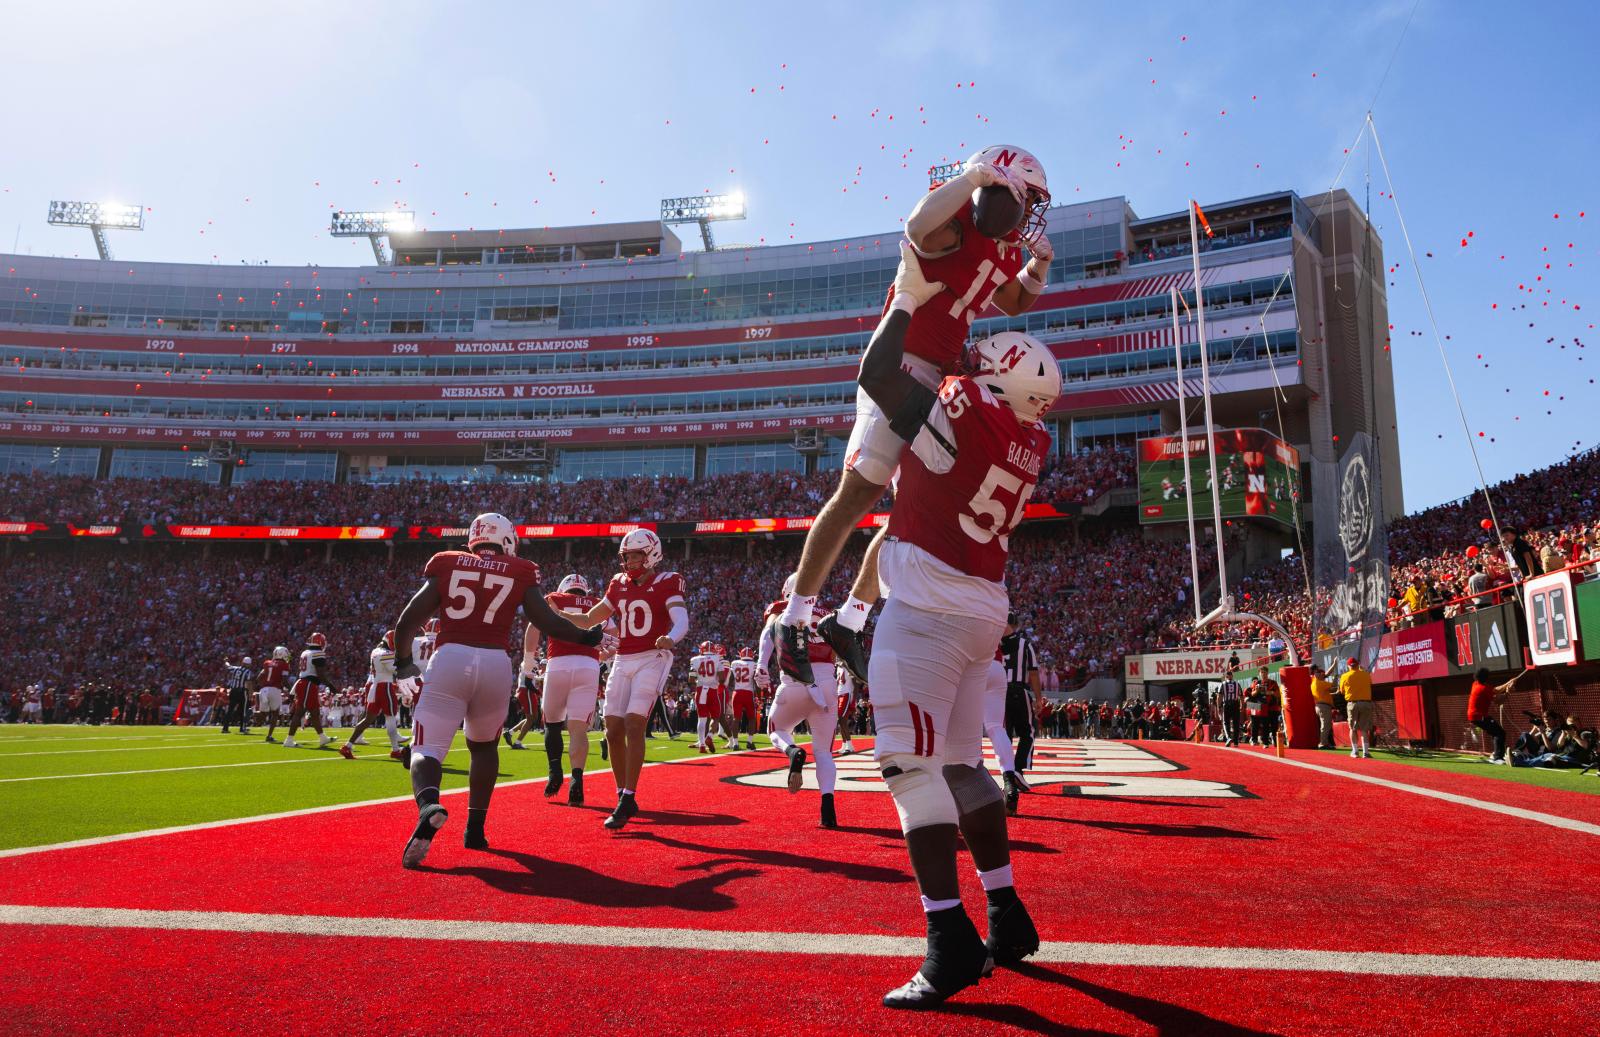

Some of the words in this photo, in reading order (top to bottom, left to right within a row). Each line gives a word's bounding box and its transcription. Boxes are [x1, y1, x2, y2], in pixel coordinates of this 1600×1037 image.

[992, 149, 1017, 168] N
[145, 339, 175, 350] 1970
[271, 343, 297, 353] 1971
[392, 343, 419, 353] 1994
[454, 341, 516, 353] NATIONAL
[517, 339, 590, 351] CHAMPIONS
[626, 335, 654, 346] 1995
[744, 327, 772, 339] 1997
[1000, 345, 1027, 370] N
[441, 386, 506, 399] NEBRASKA
[513, 385, 525, 397] N
[531, 383, 596, 396] FOOTBALL
[938, 378, 972, 420] 55
[51, 425, 70, 433] 1935
[80, 426, 99, 434] 1936
[108, 427, 126, 435] 1937
[137, 428, 156, 436] 1940
[164, 429, 183, 437] 1963
[192, 429, 211, 437] 1964
[219, 430, 237, 438] 1966
[246, 430, 265, 438] 1969
[352, 431, 370, 439] 1975
[456, 430, 517, 439] CONFERENCE
[519, 429, 573, 438] CHAMPIONS
[608, 427, 625, 435] 1982
[633, 426, 651, 434] 1983
[660, 425, 677, 433] 1984
[711, 422, 728, 430] 1991
[736, 421, 754, 429] 1992
[763, 420, 781, 428] 1993
[789, 418, 807, 426] 1994
[816, 416, 834, 425] 1995
[842, 414, 857, 423] 199
[1248, 474, 1265, 493] N
[269, 528, 299, 536] TOUCHDOWN
[525, 526, 555, 536] TOUCHDOWN
[695, 521, 725, 531] TOUCHDOWN
[456, 555, 510, 573] PRITCHETT
[445, 569, 515, 625] 57
[617, 599, 653, 639] 10
[1454, 622, 1474, 666] N
[1396, 653, 1415, 667] CANCER
[1415, 649, 1434, 664] CENTER
[698, 660, 715, 677] 40
[735, 667, 750, 683] 32
[1129, 662, 1139, 676] N
